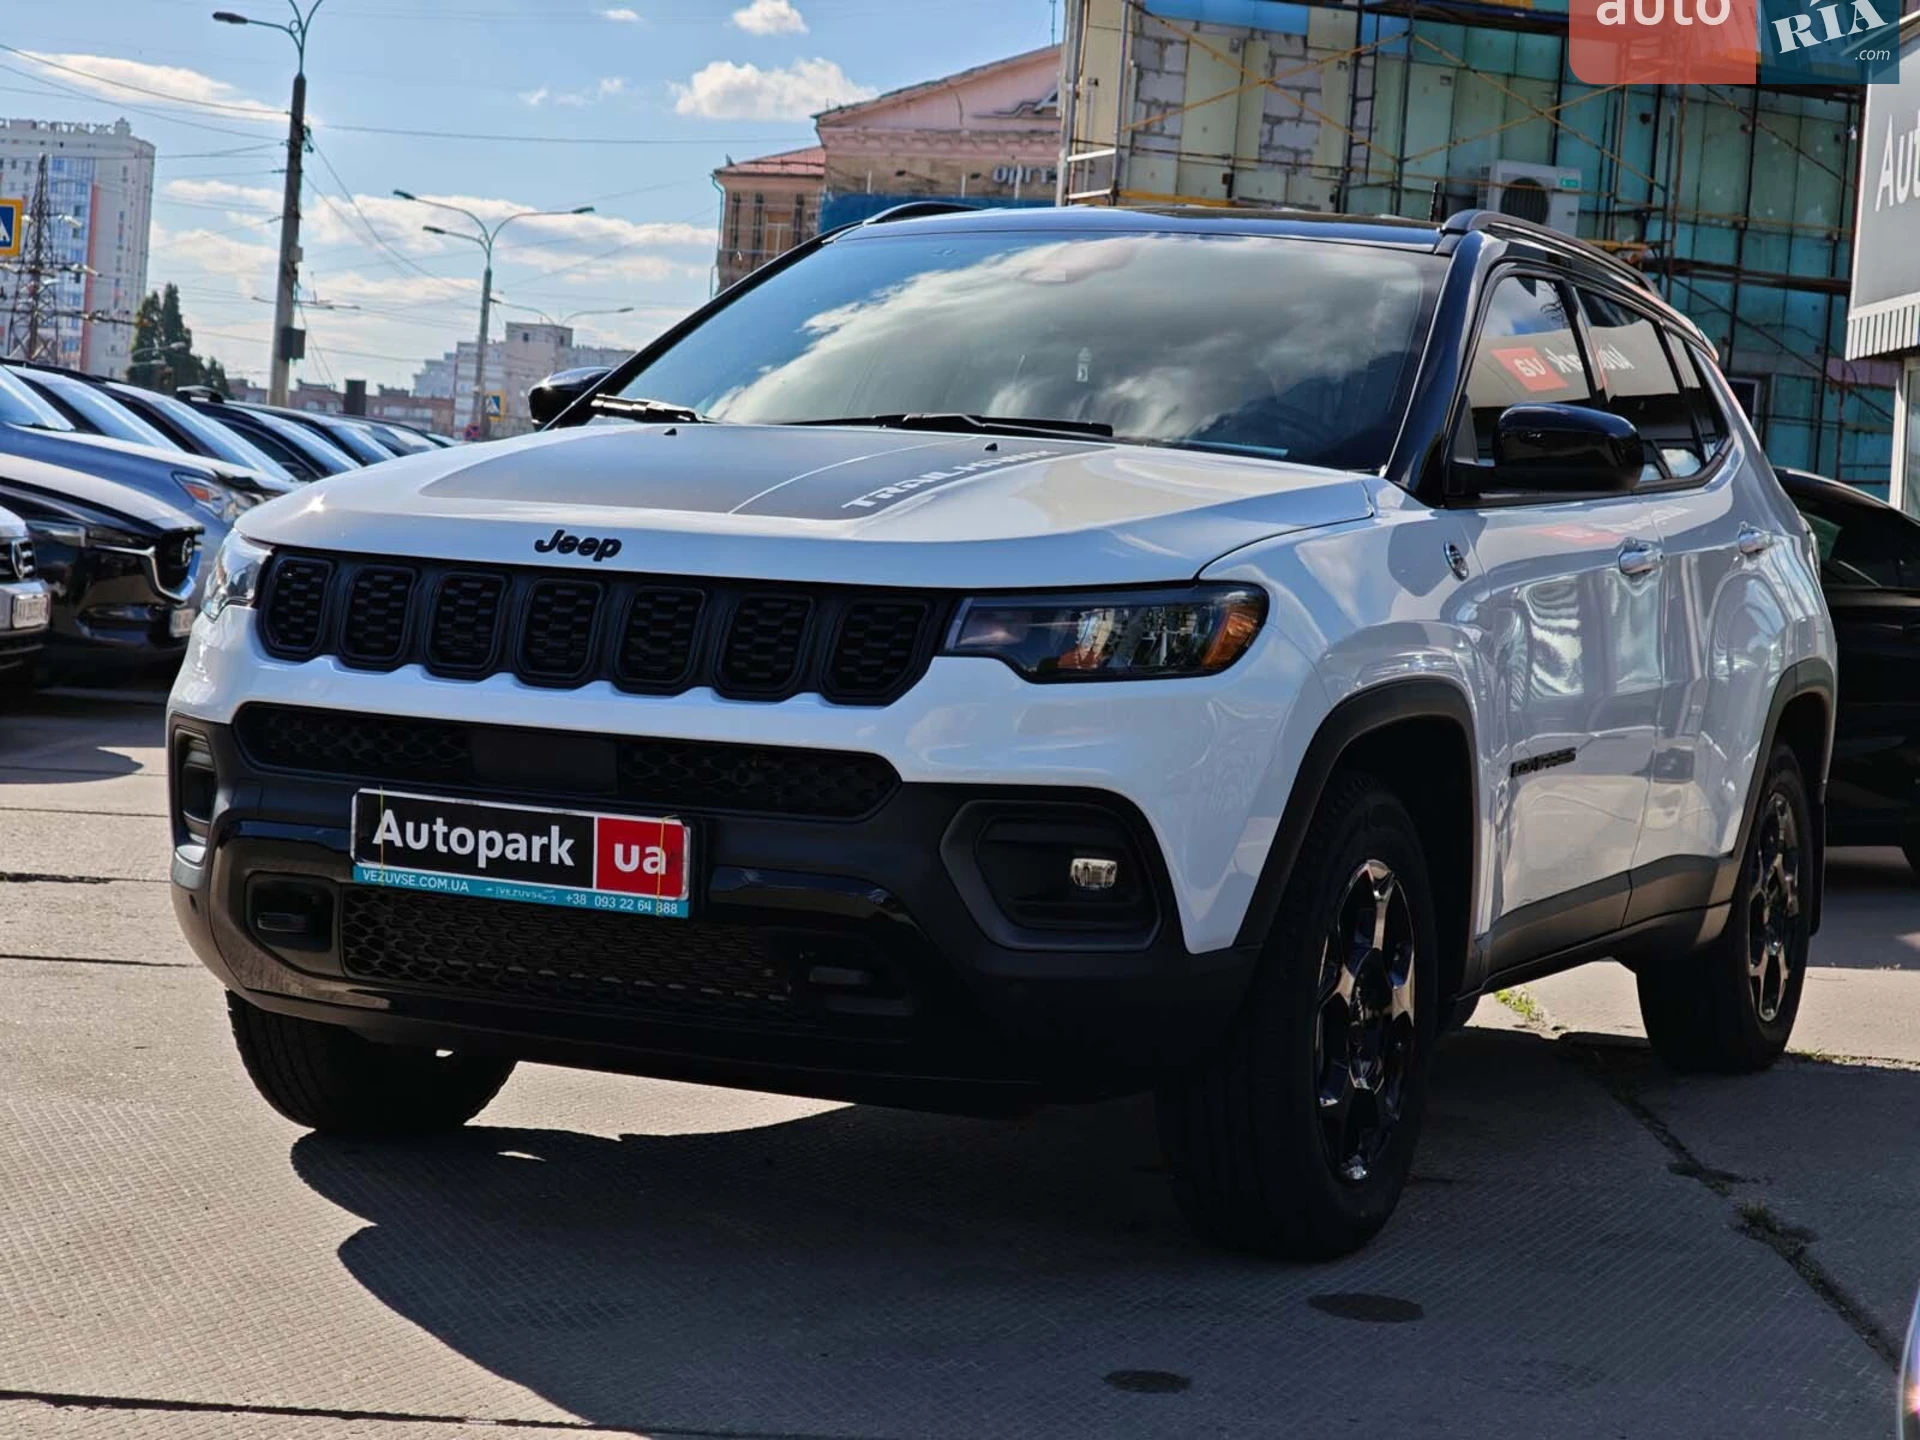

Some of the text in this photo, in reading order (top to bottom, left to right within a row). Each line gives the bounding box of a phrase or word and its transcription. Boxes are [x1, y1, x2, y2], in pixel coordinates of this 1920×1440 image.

[534, 529, 622, 562] Jeep
[372, 809, 667, 875] Autopark ua
[362, 869, 469, 892] VEZUVSE.COM.UA
[566, 893, 678, 914] +38 093 22 64 888
